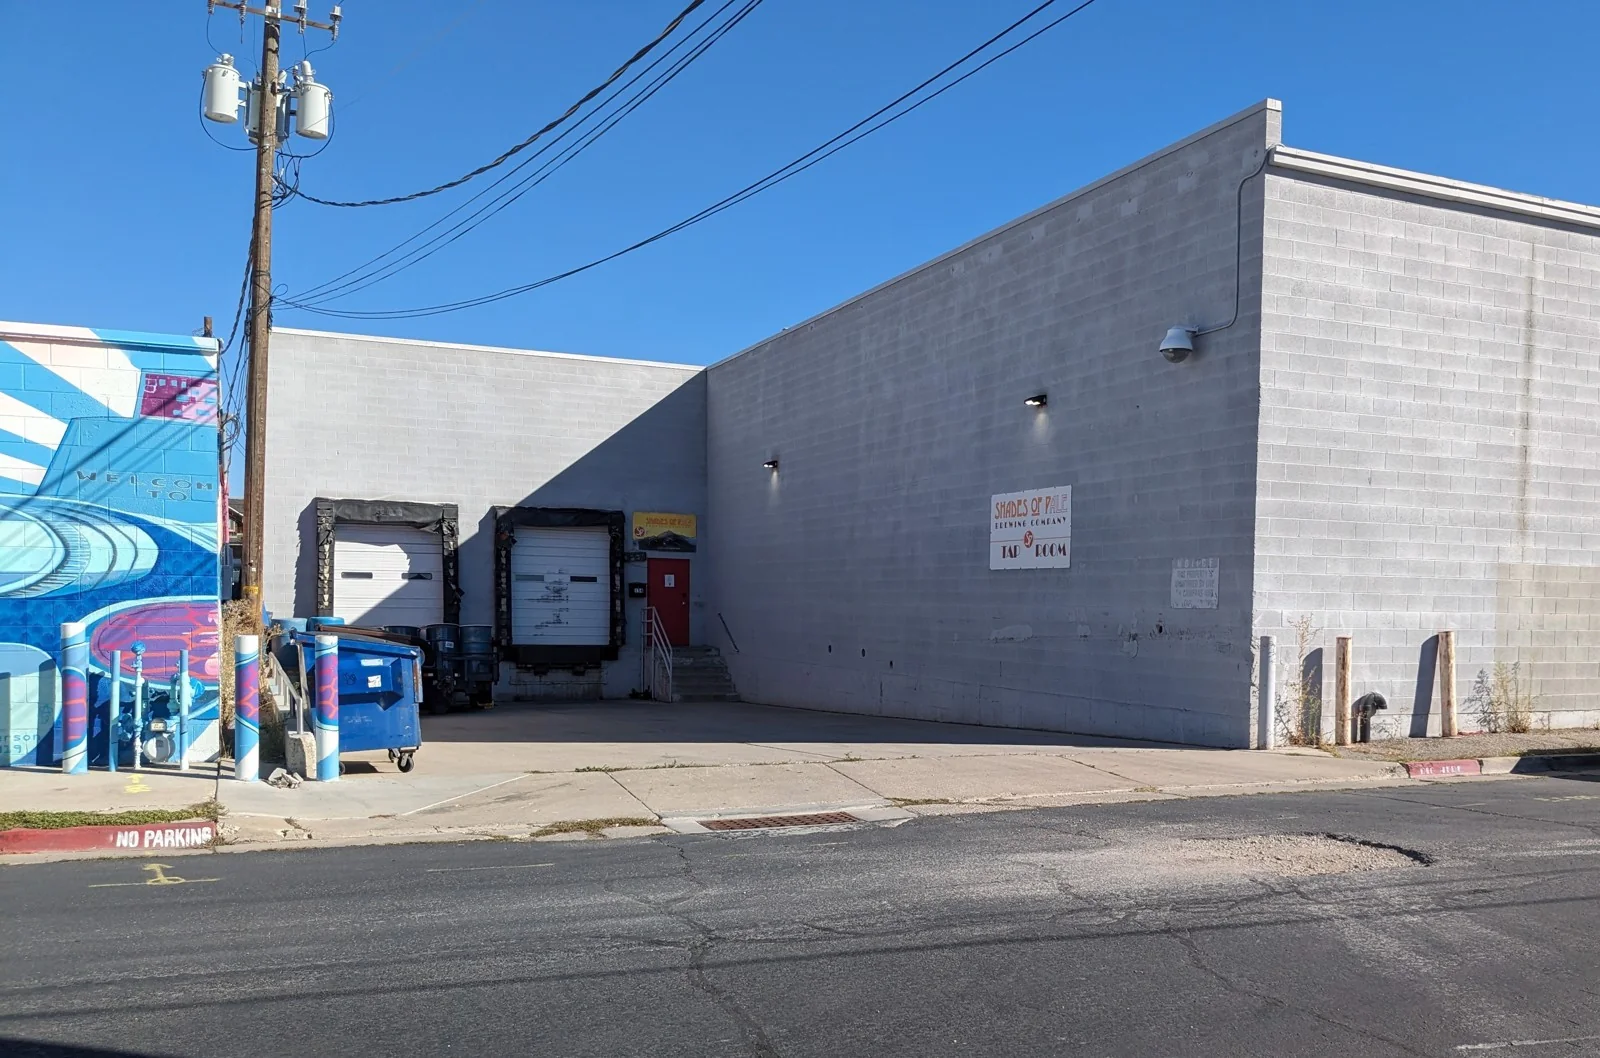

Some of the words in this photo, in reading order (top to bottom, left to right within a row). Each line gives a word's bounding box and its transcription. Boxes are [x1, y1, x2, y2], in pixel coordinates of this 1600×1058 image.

[149, 490, 187, 501] TO
[995, 499, 1028, 519] SHADES
[1031, 497, 1042, 516] OF
[1045, 494, 1068, 514] PALE
[995, 520, 1026, 530] BREWING
[1031, 517, 1066, 526] COMPANY
[1001, 545, 1020, 559] TAP
[1035, 543, 1067, 557] ROOM
[116, 830, 139, 848] NO
